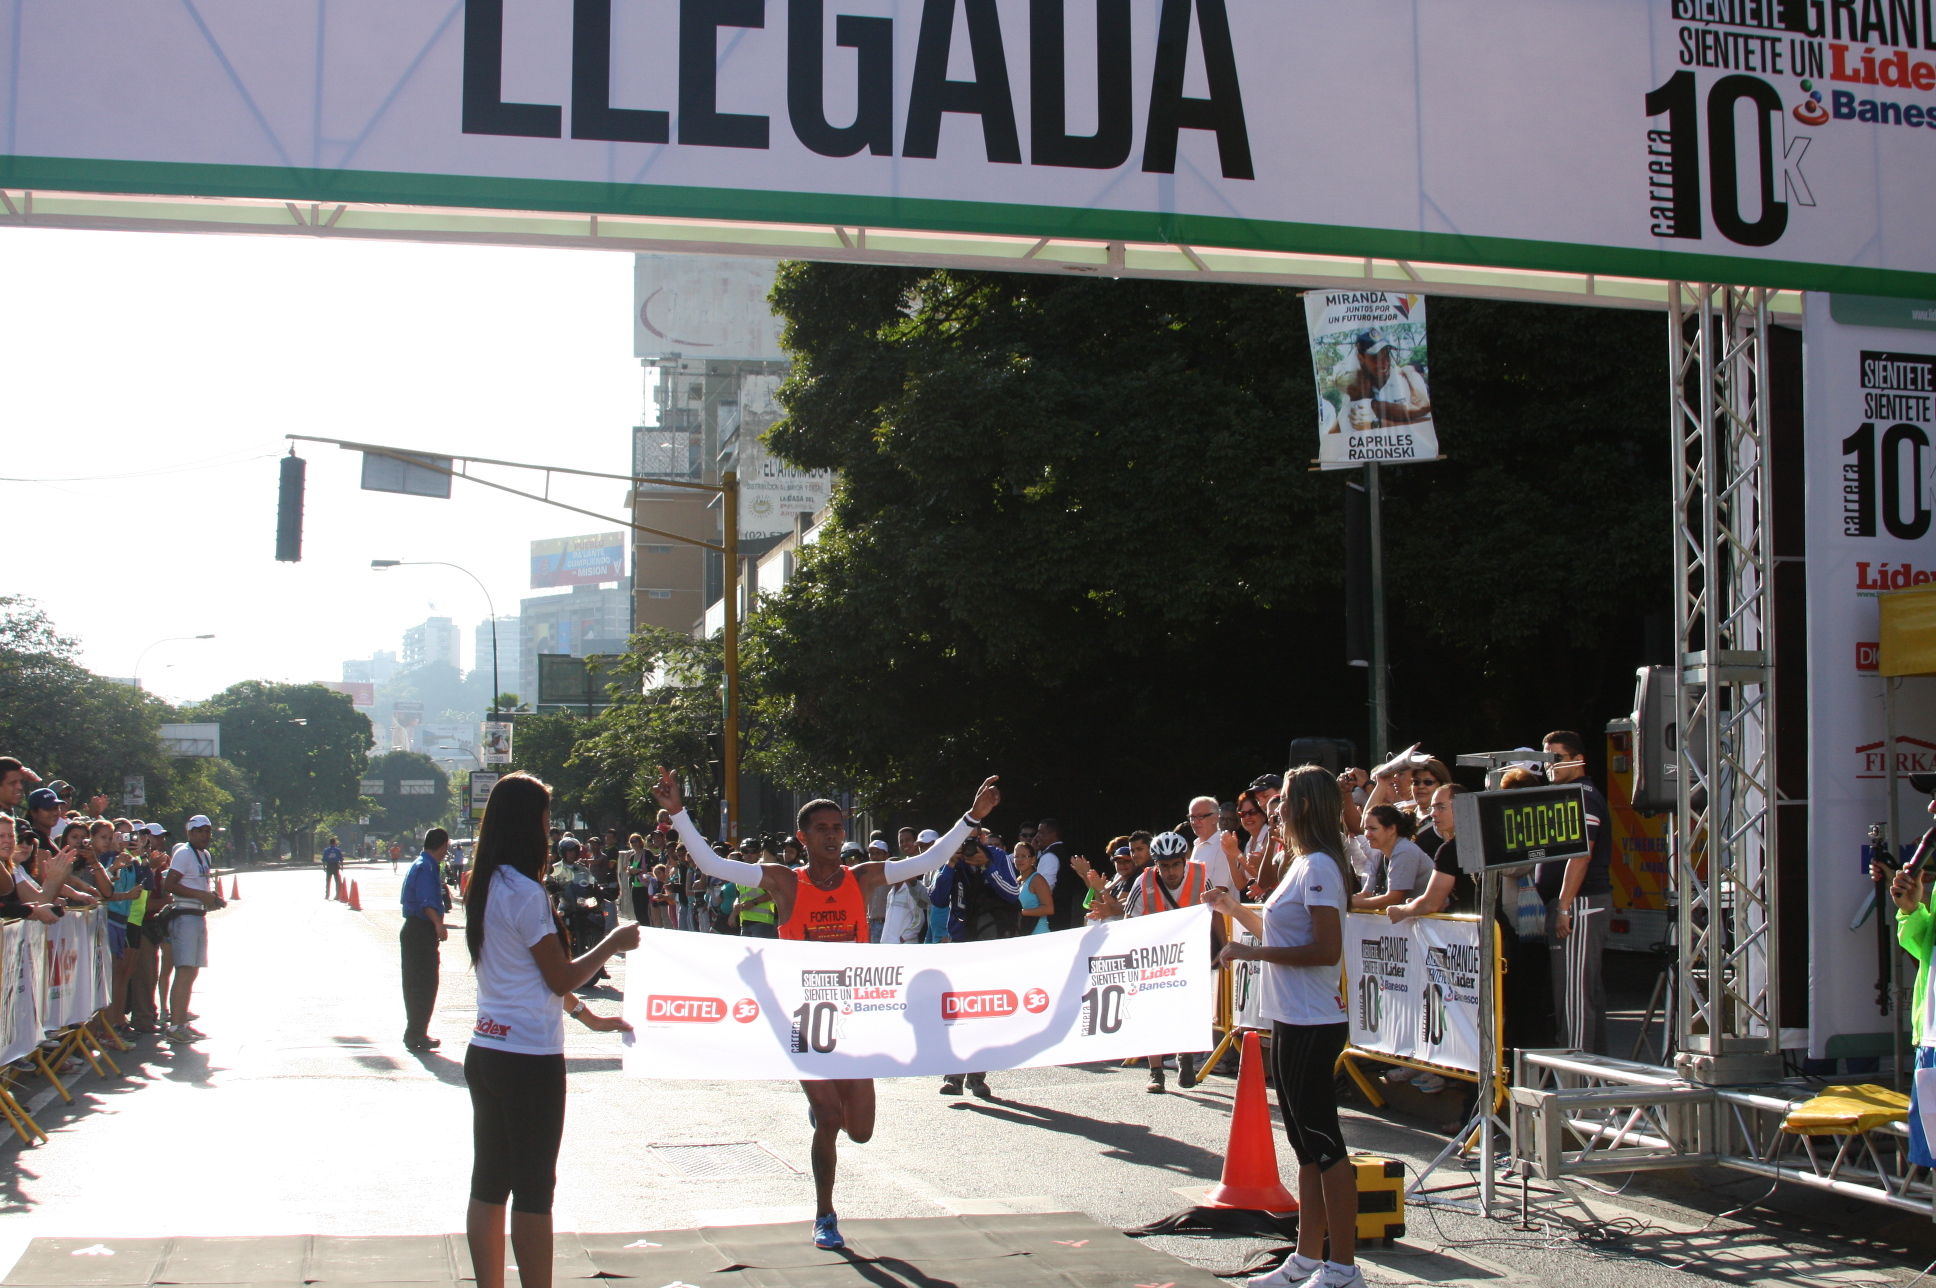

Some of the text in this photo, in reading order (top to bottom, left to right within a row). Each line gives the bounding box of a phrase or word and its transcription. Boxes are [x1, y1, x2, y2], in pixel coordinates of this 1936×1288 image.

[1679, 22, 1936, 92] SIÉNTETE UN Líde
[462, 0, 1255, 180] LLEGADA
[1647, 130, 1676, 238] carrera
[1326, 292, 1388, 306] MIRANDA
[1345, 305, 1390, 314] JUNTOS POR
[1328, 314, 1398, 324] UN FUTURO MEJOR
[1864, 354, 1933, 391] SIÉNTETE
[1864, 389, 1931, 422] SIÉNTETE
[1349, 434, 1413, 449] CAPRILES
[1349, 446, 1415, 460] RADONSKI
[1843, 463, 1860, 537] carrera
[1856, 562, 1936, 590] Líde
[1504, 801, 1581, 850] 0:00:00
[810, 910, 847, 922] FORTIUS
[1130, 942, 1186, 970] GRANDE
[1380, 936, 1408, 963] GRANDE
[1446, 943, 1479, 974] GRANDE
[844, 966, 904, 987] GRANDE
[1127, 969, 1139, 983] UN
[1140, 966, 1178, 981] Líder
[840, 988, 852, 1000] UN
[853, 987, 897, 1000] Líder
[1139, 979, 1188, 992] Banesco
[651, 999, 757, 1018] DIGITEL 3G
[854, 1002, 908, 1012] Banesco
[946, 993, 1046, 1014] DIGITEL 3G
[474, 1017, 511, 1036] íder
[1081, 1005, 1091, 1037] carrera
[791, 1021, 801, 1053] carrera
